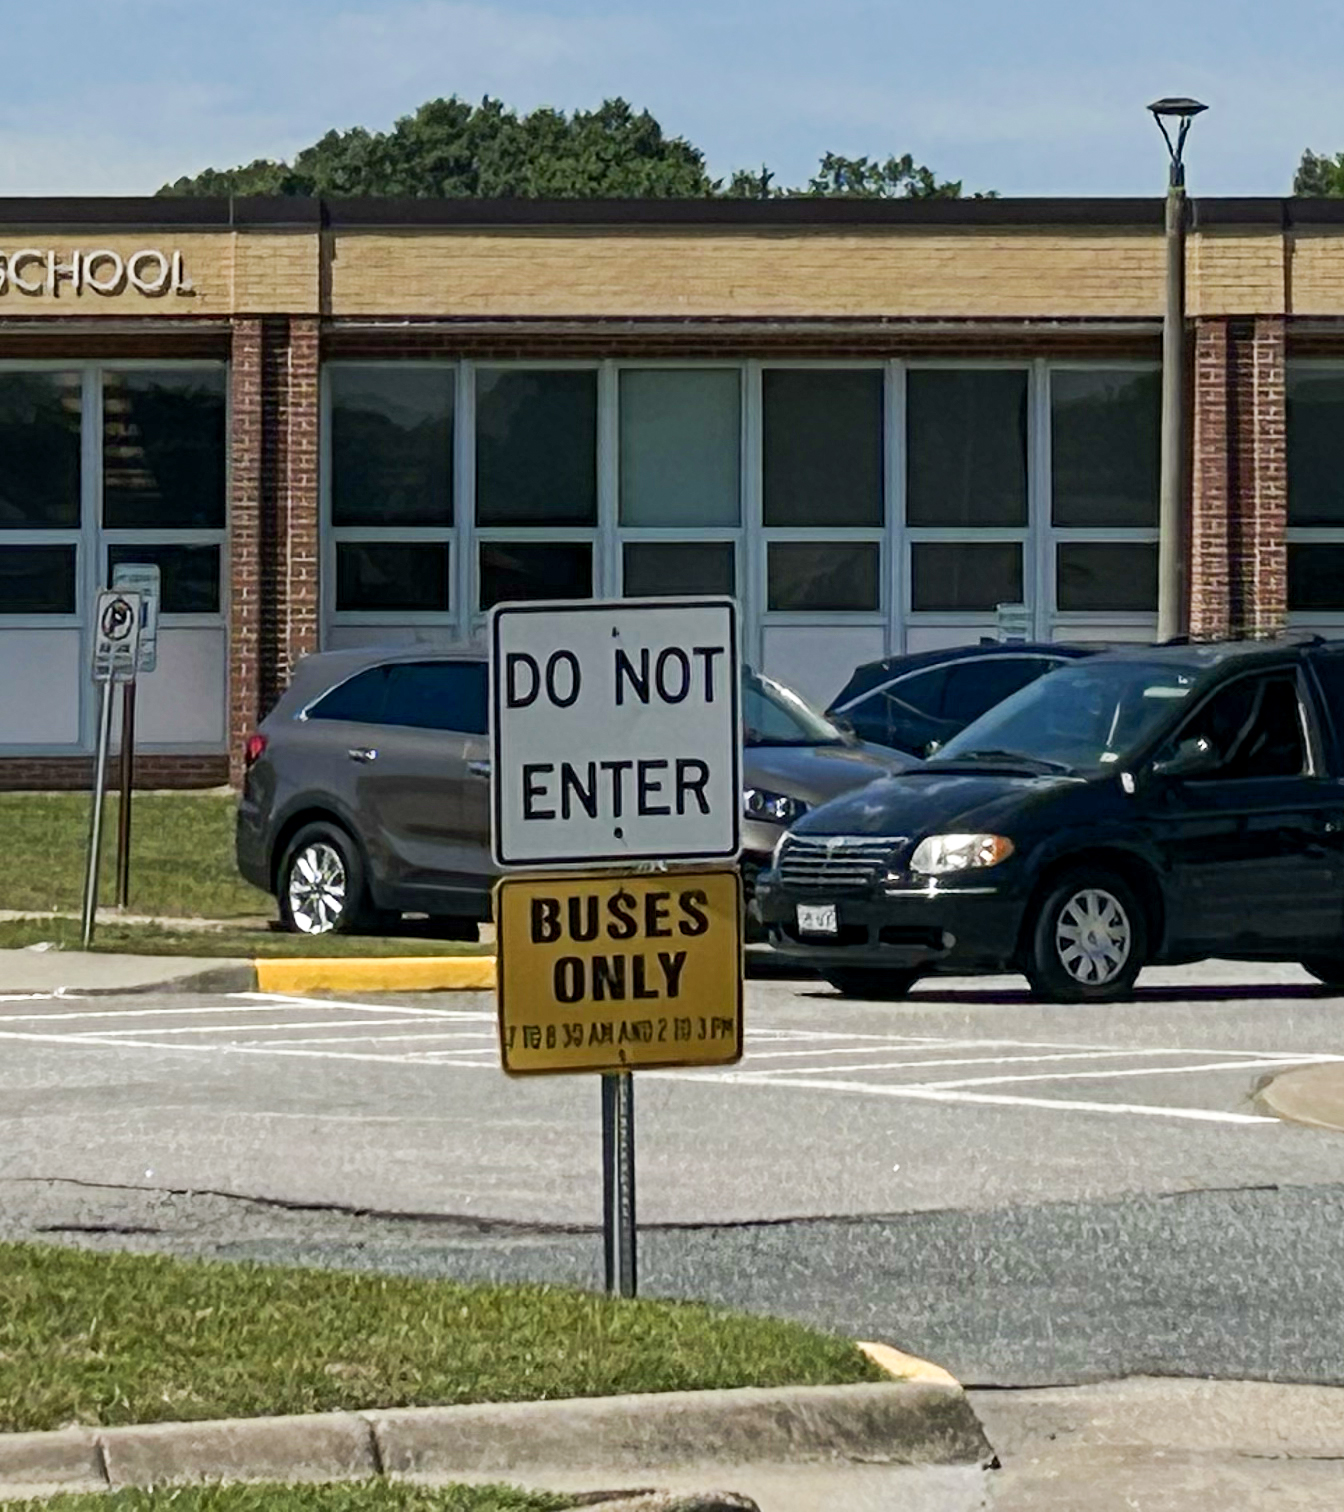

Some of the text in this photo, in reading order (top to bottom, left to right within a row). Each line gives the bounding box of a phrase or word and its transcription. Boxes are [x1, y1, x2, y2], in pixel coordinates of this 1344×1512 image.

[506, 646, 724, 708] DO NOT
[522, 758, 711, 821] ENTER
[531, 888, 709, 944] BUSES
[553, 951, 687, 1003] ONLY
[657, 1017, 667, 1042] 2
